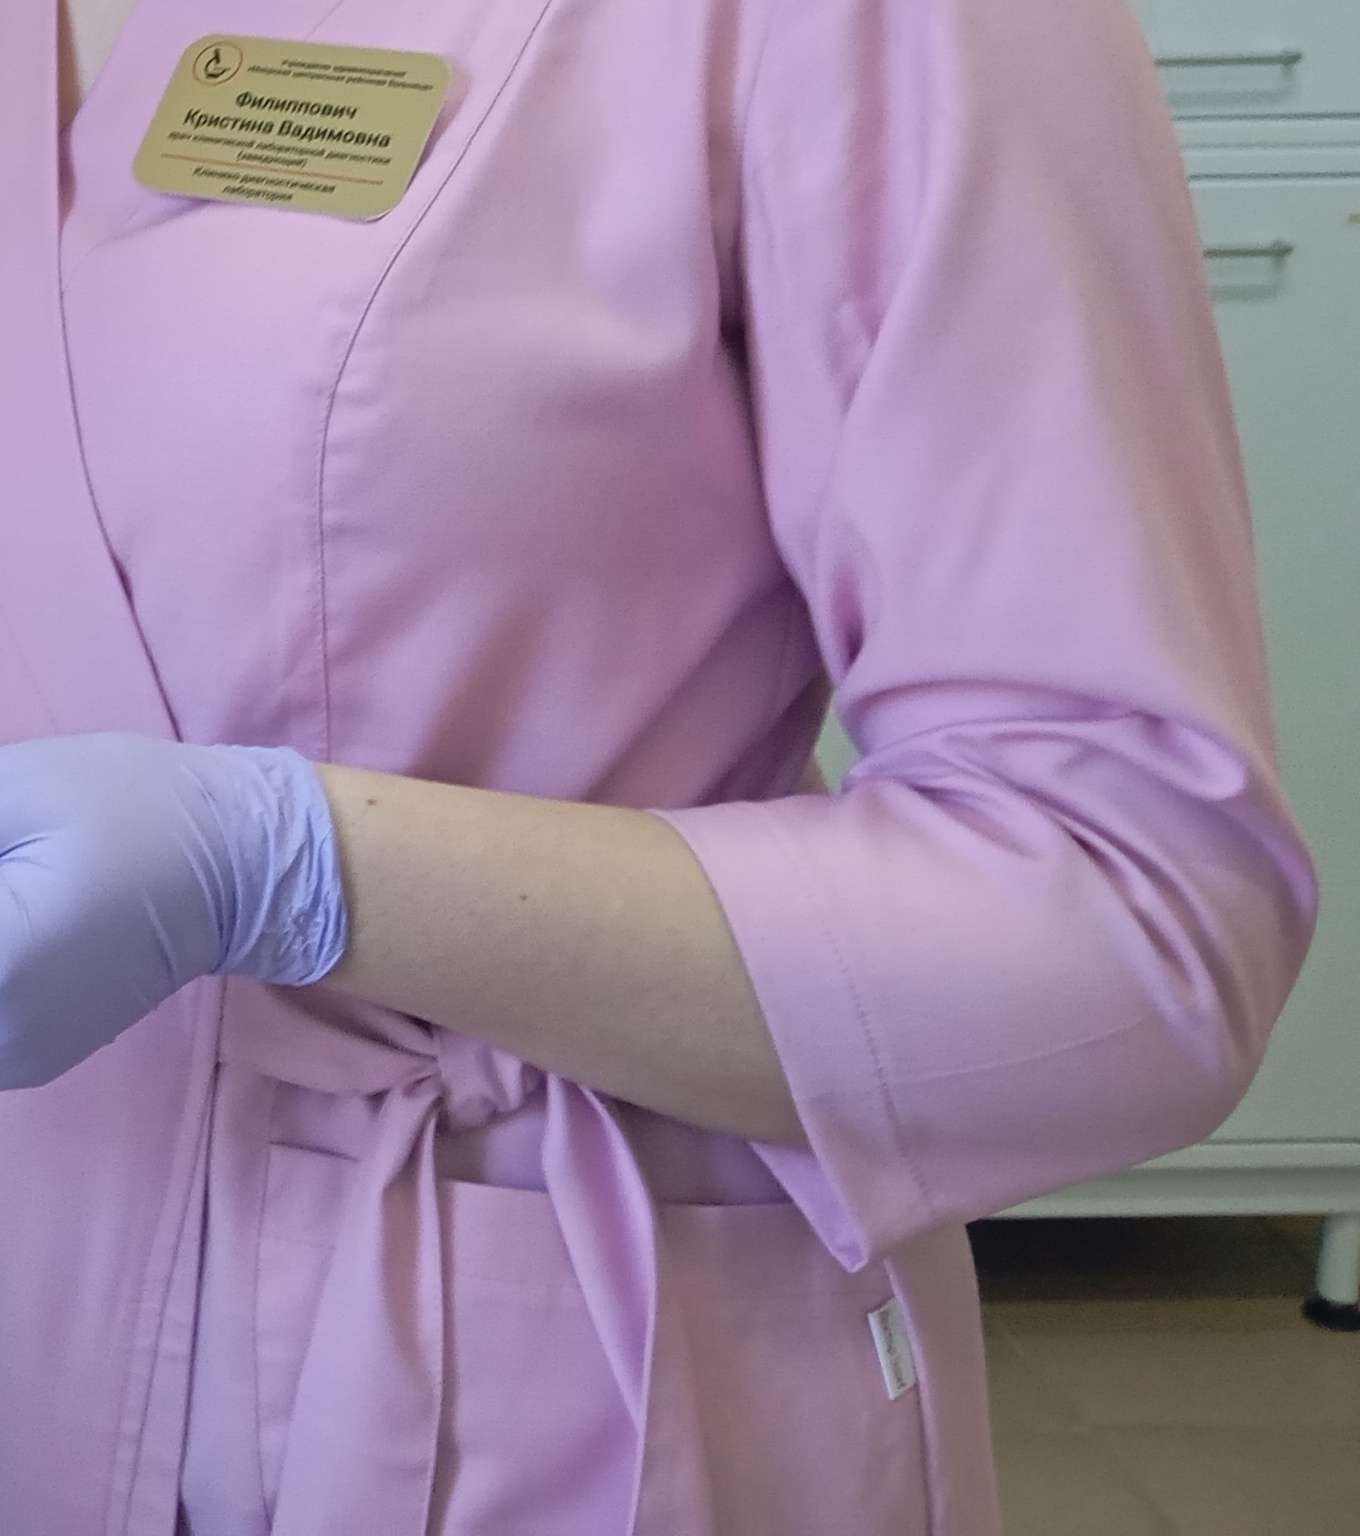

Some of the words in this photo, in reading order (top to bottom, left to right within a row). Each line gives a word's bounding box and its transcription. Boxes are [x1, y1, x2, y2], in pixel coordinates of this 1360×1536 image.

[236, 90, 359, 119] Филиппович
[183, 107, 274, 135] Кристина
[277, 120, 392, 148] Вадимовна
